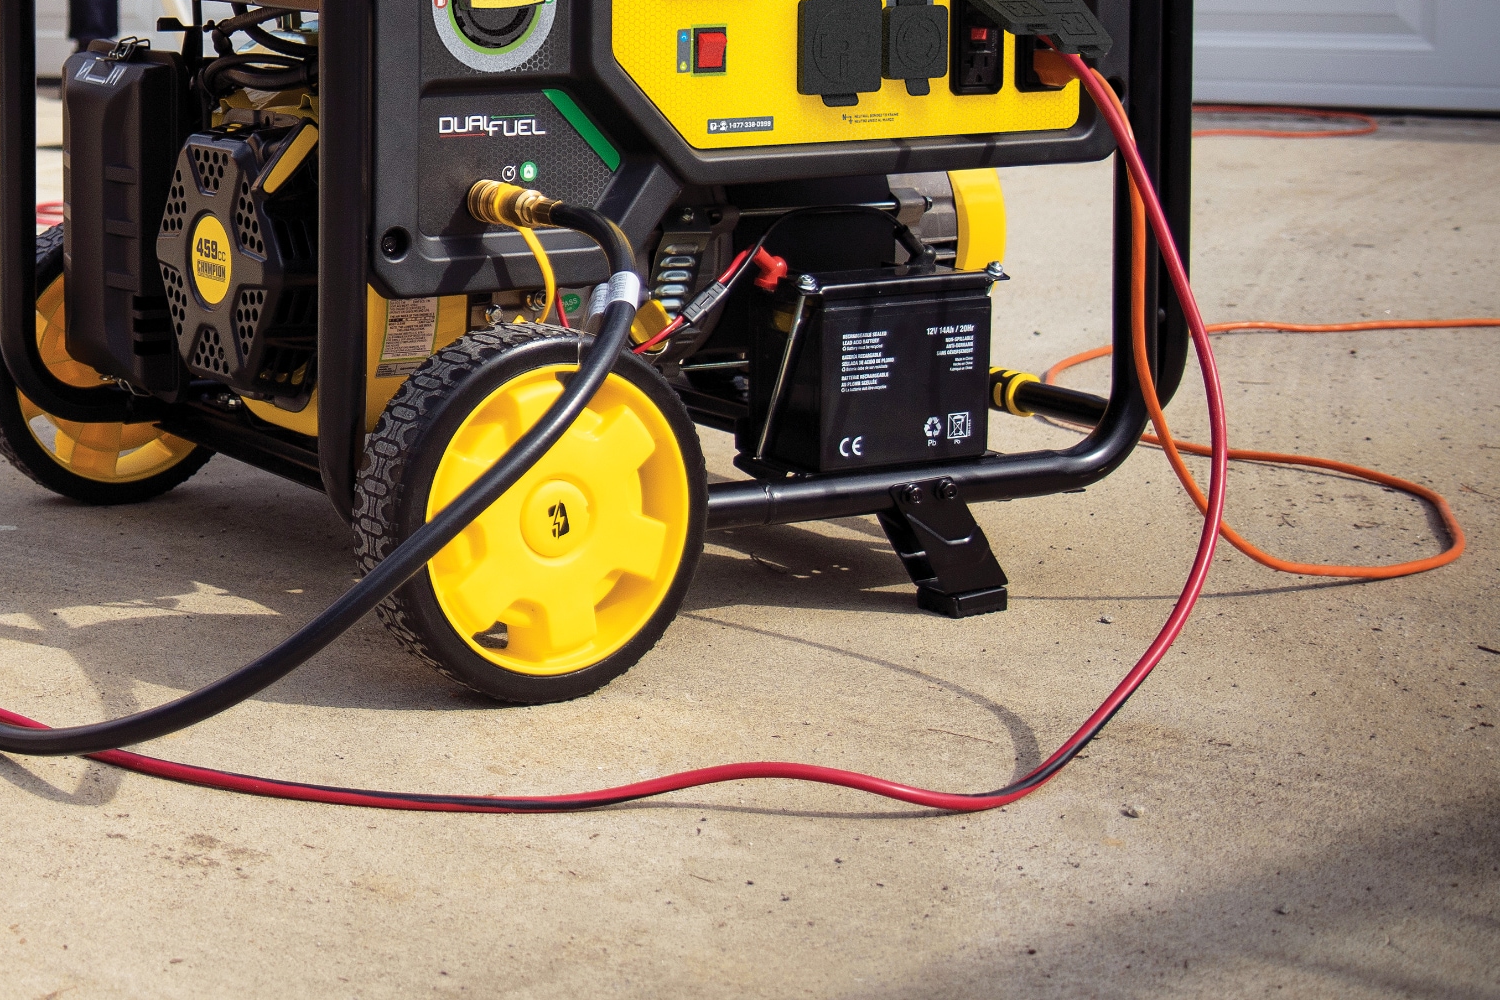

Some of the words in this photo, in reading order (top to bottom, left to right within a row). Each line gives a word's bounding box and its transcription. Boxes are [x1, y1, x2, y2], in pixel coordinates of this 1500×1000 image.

[197, 259, 226, 279] CHAMPION
[926, 326, 938, 335] 12V
[960, 323, 975, 332] 20Hr
[839, 435, 862, 457] CE
[927, 439, 937, 447] Pb
